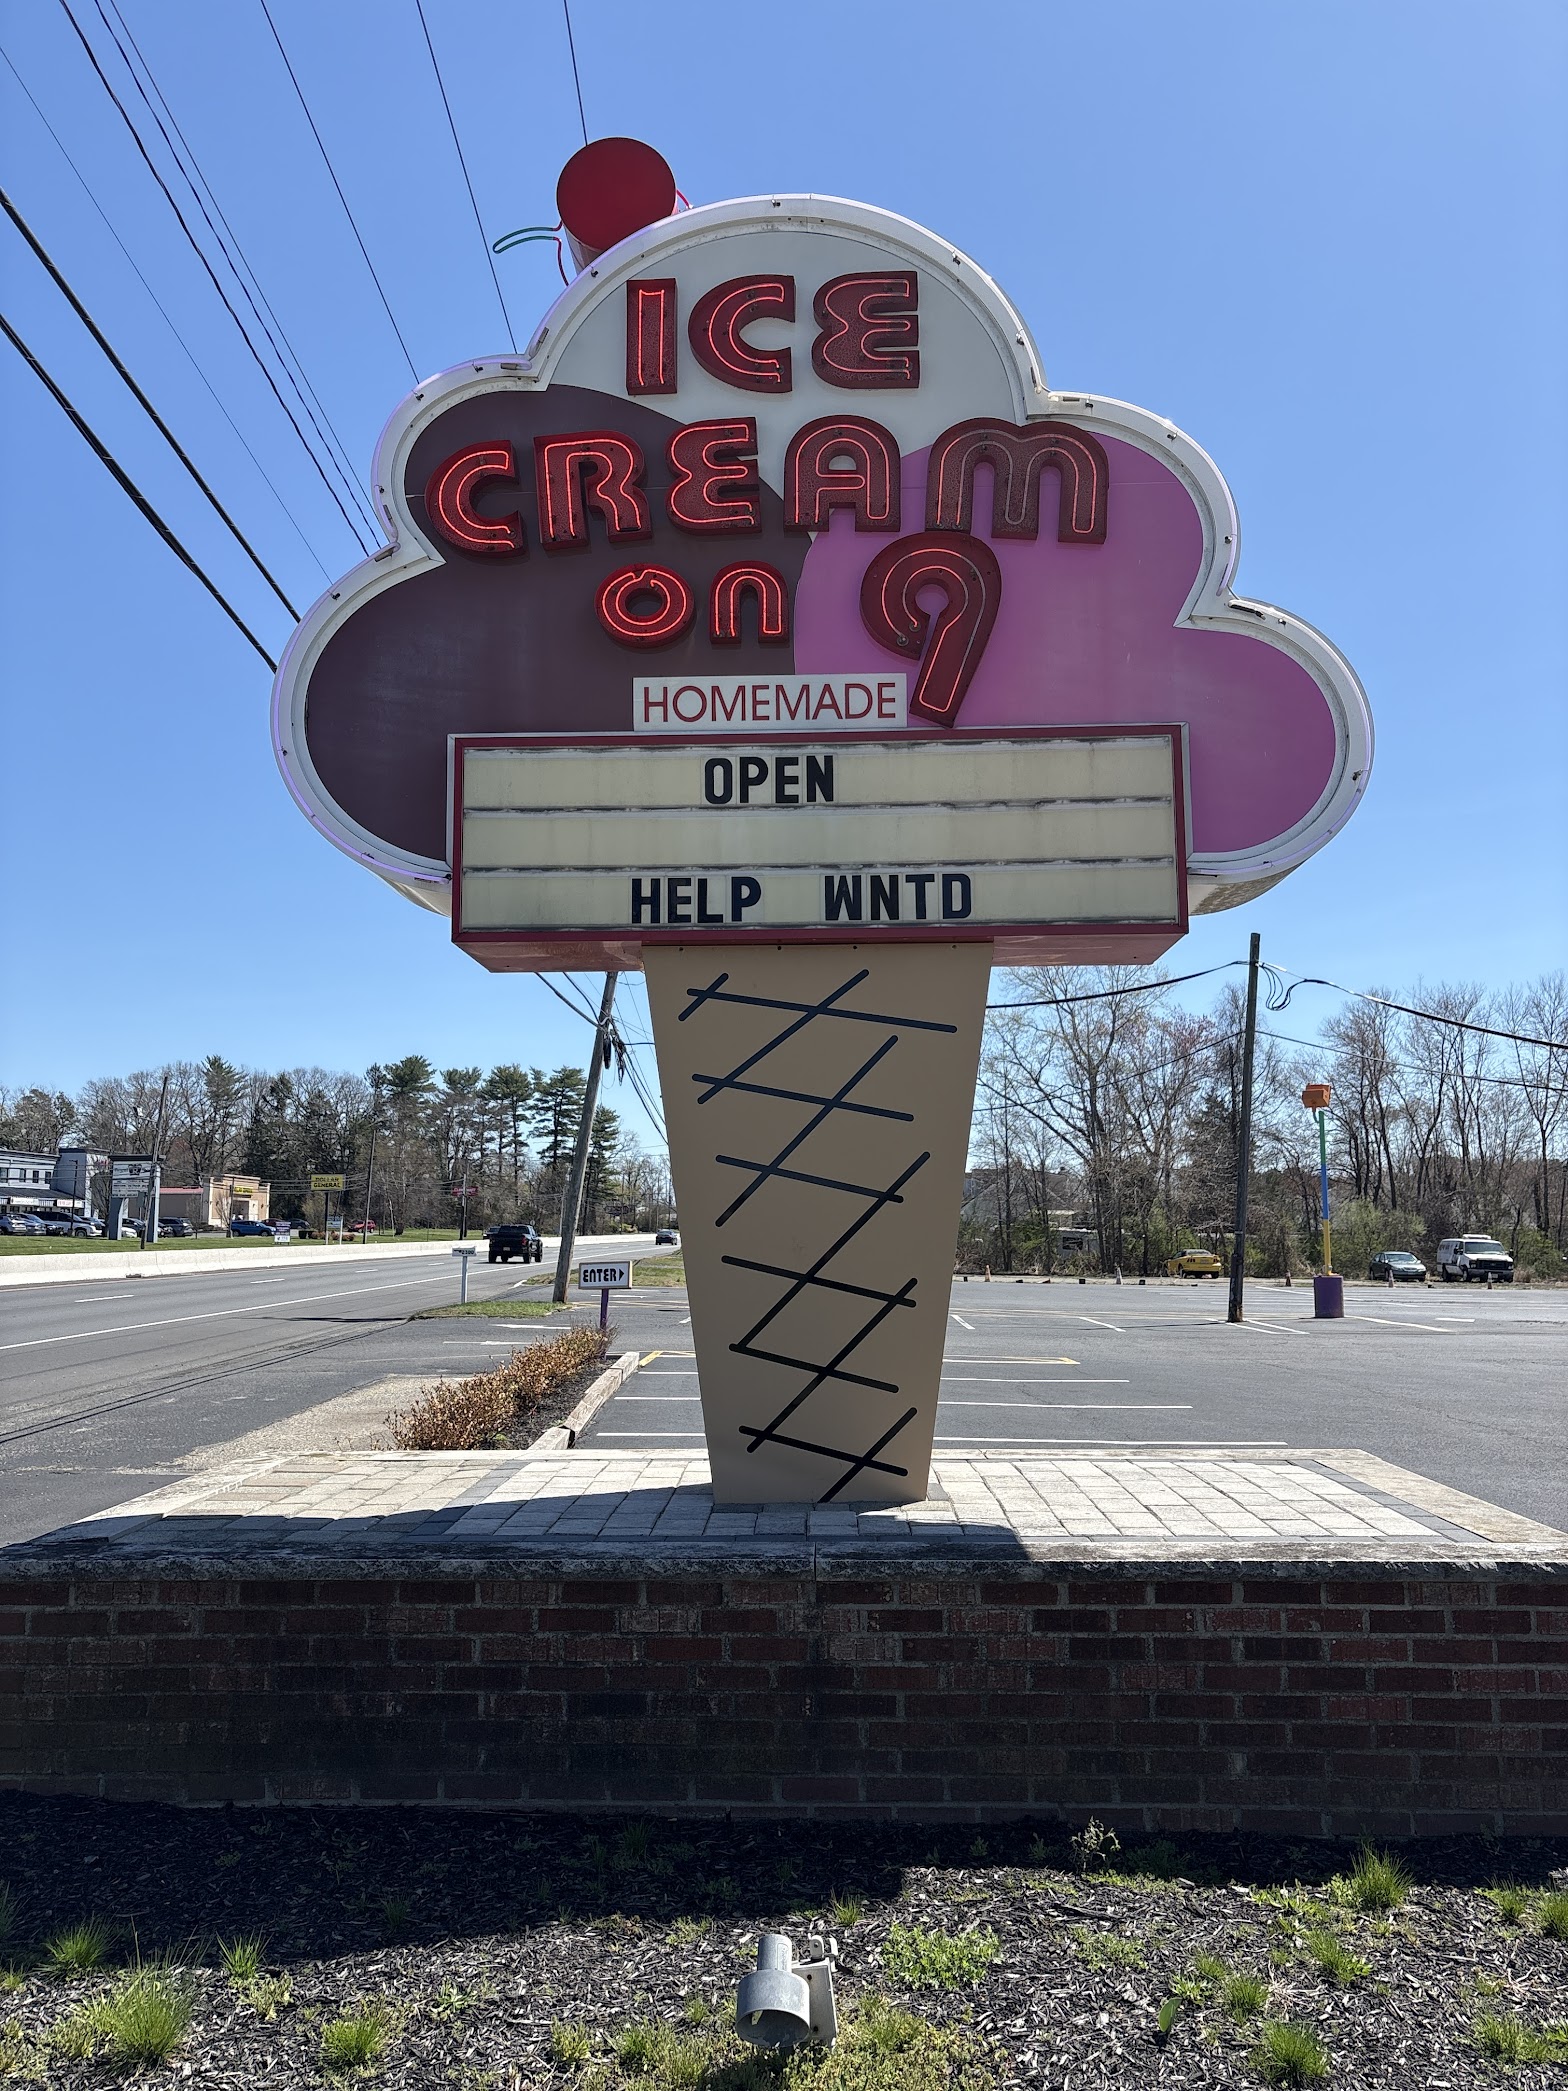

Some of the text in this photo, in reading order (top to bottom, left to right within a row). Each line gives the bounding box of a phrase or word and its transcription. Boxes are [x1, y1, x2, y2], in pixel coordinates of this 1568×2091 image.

[626, 270, 920, 395] ICE
[425, 414, 1109, 556] CREAM
[860, 531, 1002, 727] 9
[643, 682, 899, 723] HOMEMADE
[704, 754, 834, 804] OPEN
[631, 873, 971, 924] HELP WNTD
[582, 1268, 617, 1283] ENTER
